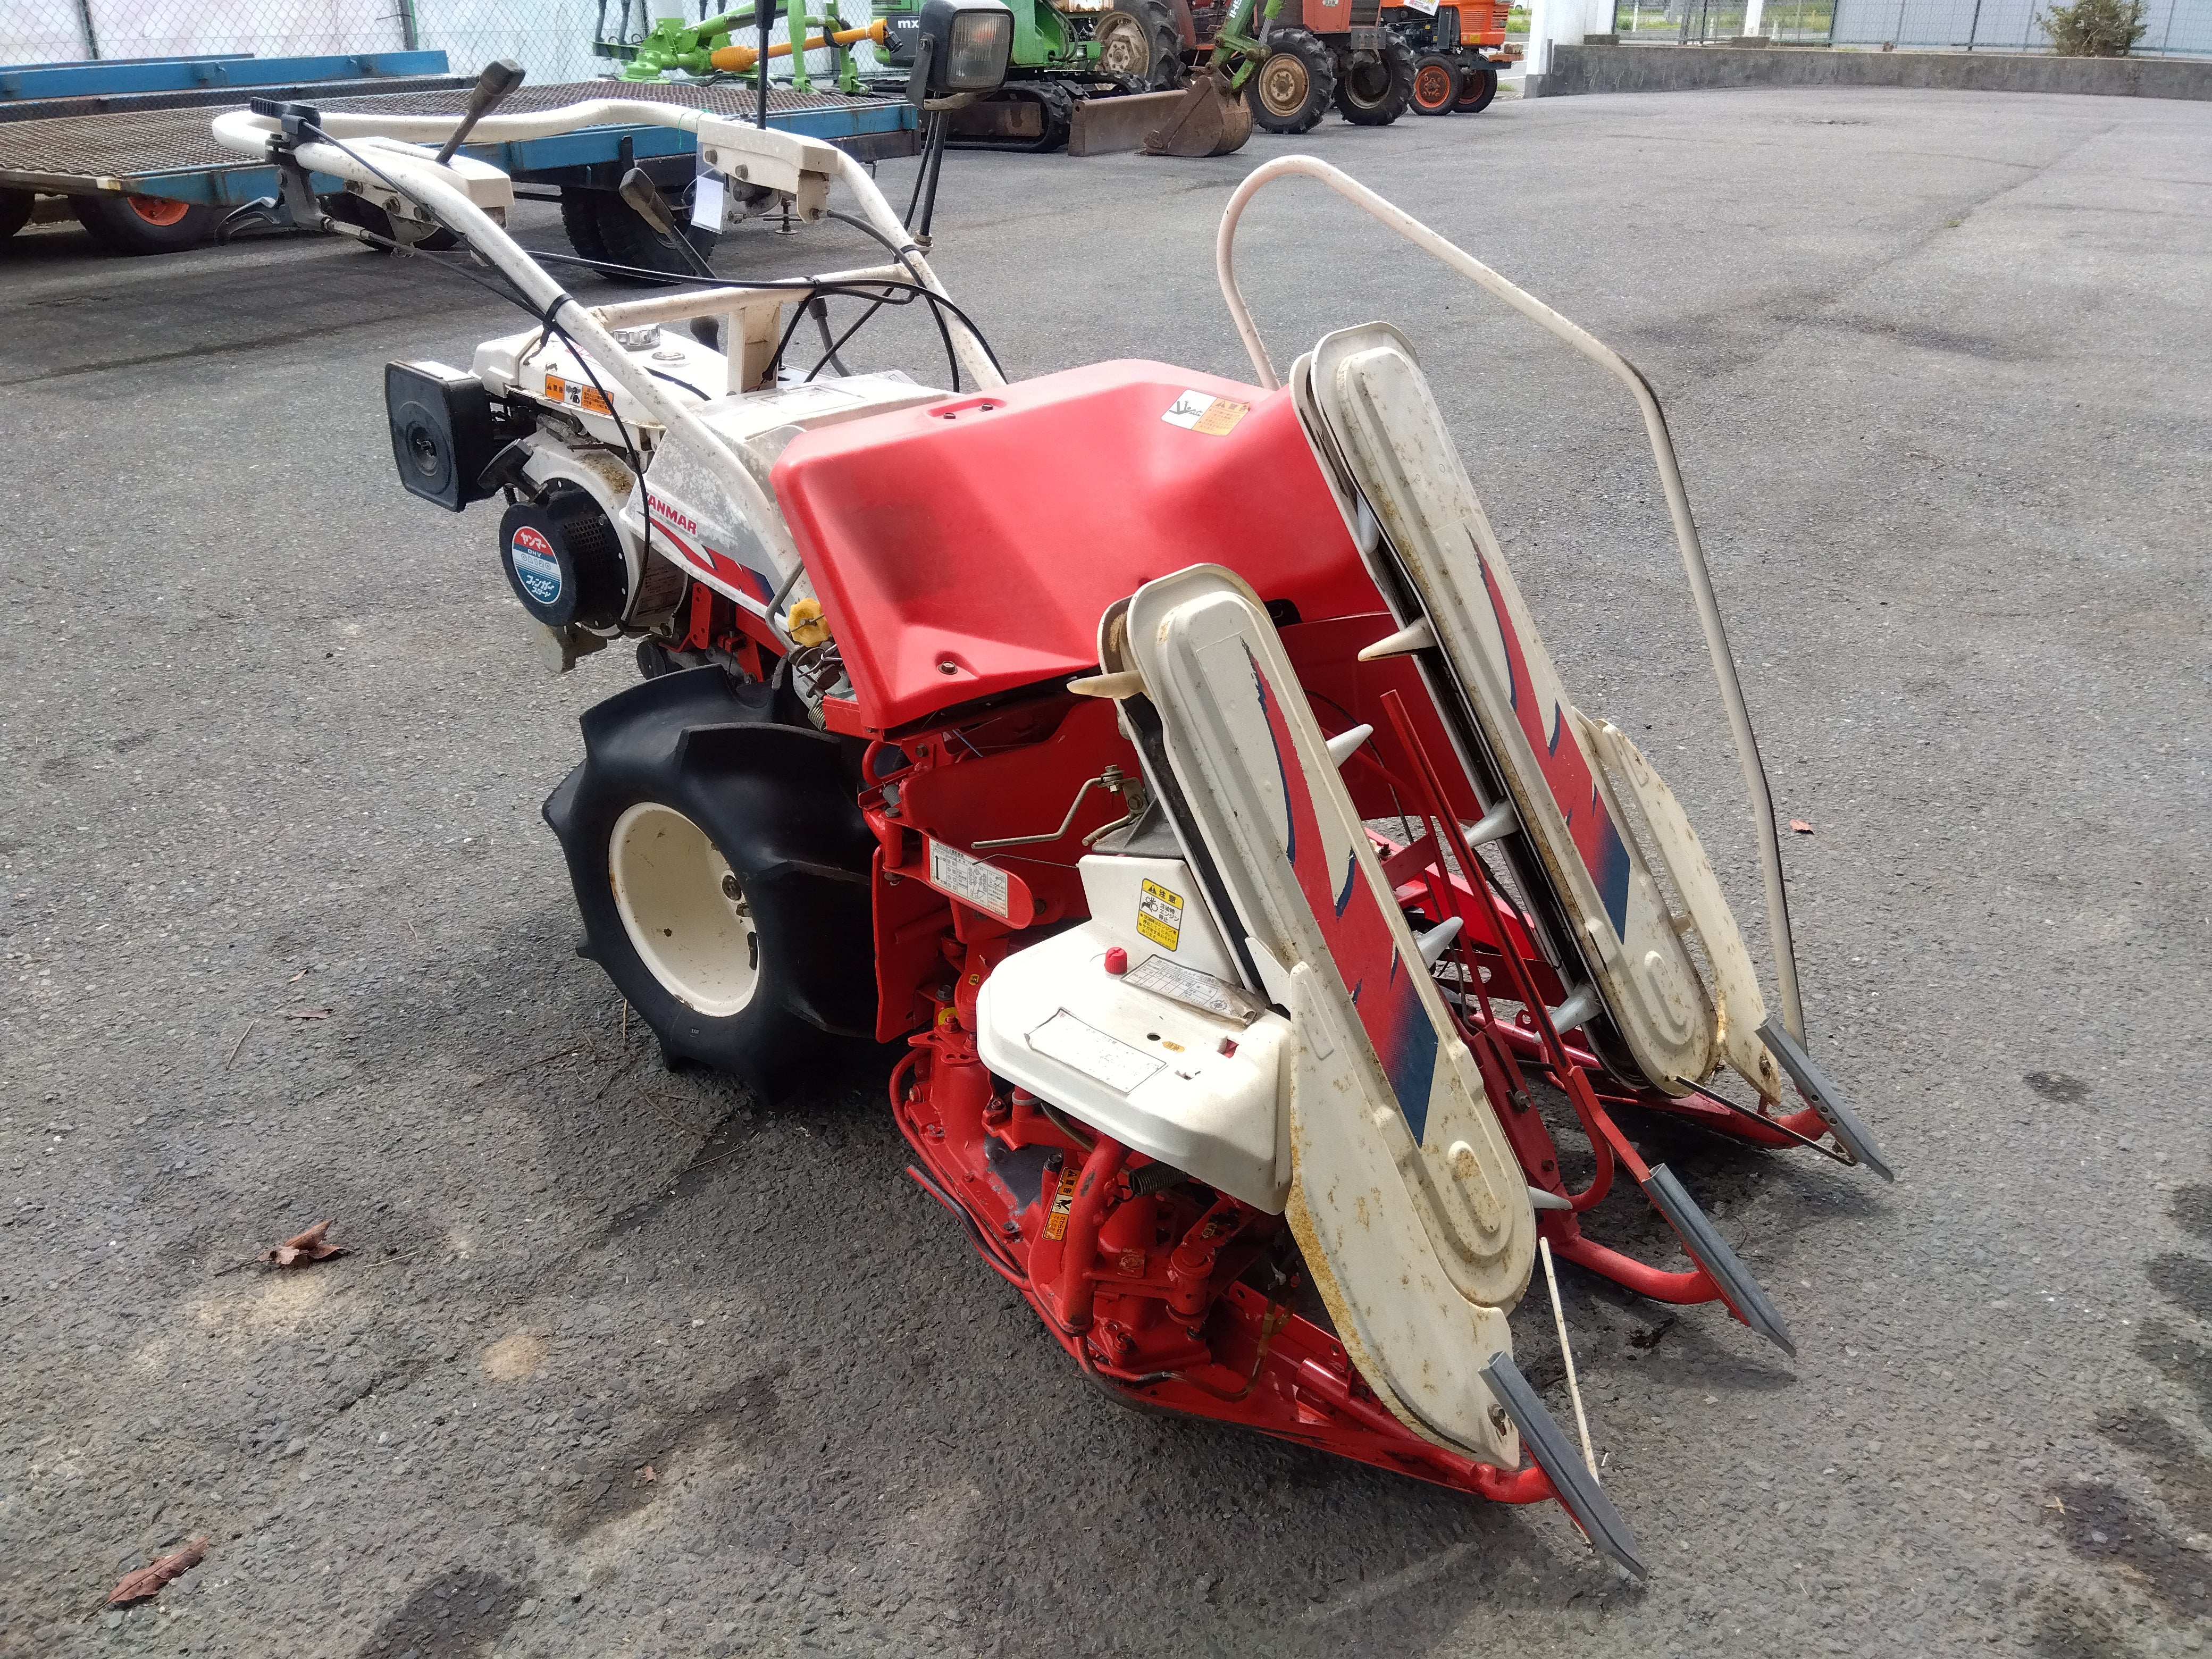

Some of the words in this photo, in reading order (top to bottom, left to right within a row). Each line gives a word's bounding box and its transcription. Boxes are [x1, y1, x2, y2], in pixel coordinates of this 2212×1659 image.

[898, 20, 919, 28] mx
[646, 492, 697, 535] ANMAR
[521, 532, 547, 550] ヤンマー
[527, 549, 541, 557] OHV
[521, 554, 551, 570] GA120
[526, 575, 555, 590] フィンガー
[1160, 908, 1179, 921] エンジン
